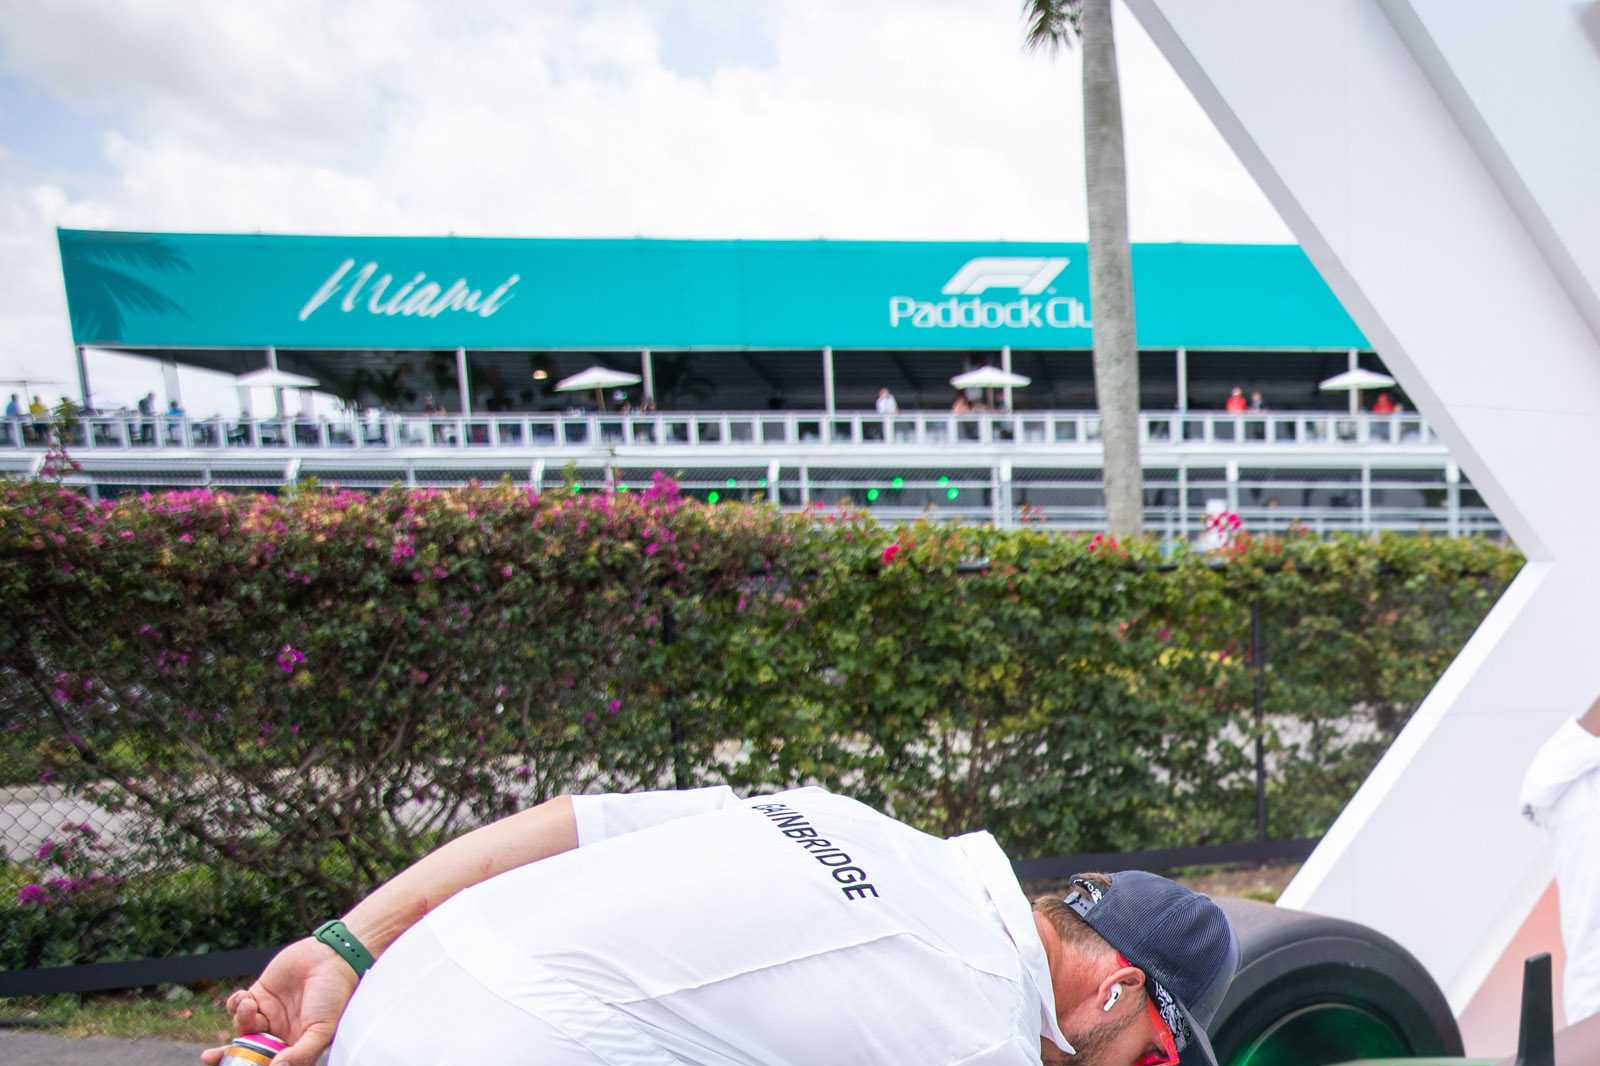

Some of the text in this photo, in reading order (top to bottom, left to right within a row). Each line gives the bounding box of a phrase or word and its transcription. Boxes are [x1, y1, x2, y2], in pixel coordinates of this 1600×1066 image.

[298, 257, 520, 321] Miami
[889, 296, 1094, 328] Paddock Clu
[751, 803, 880, 901] GAINBRIDGE
